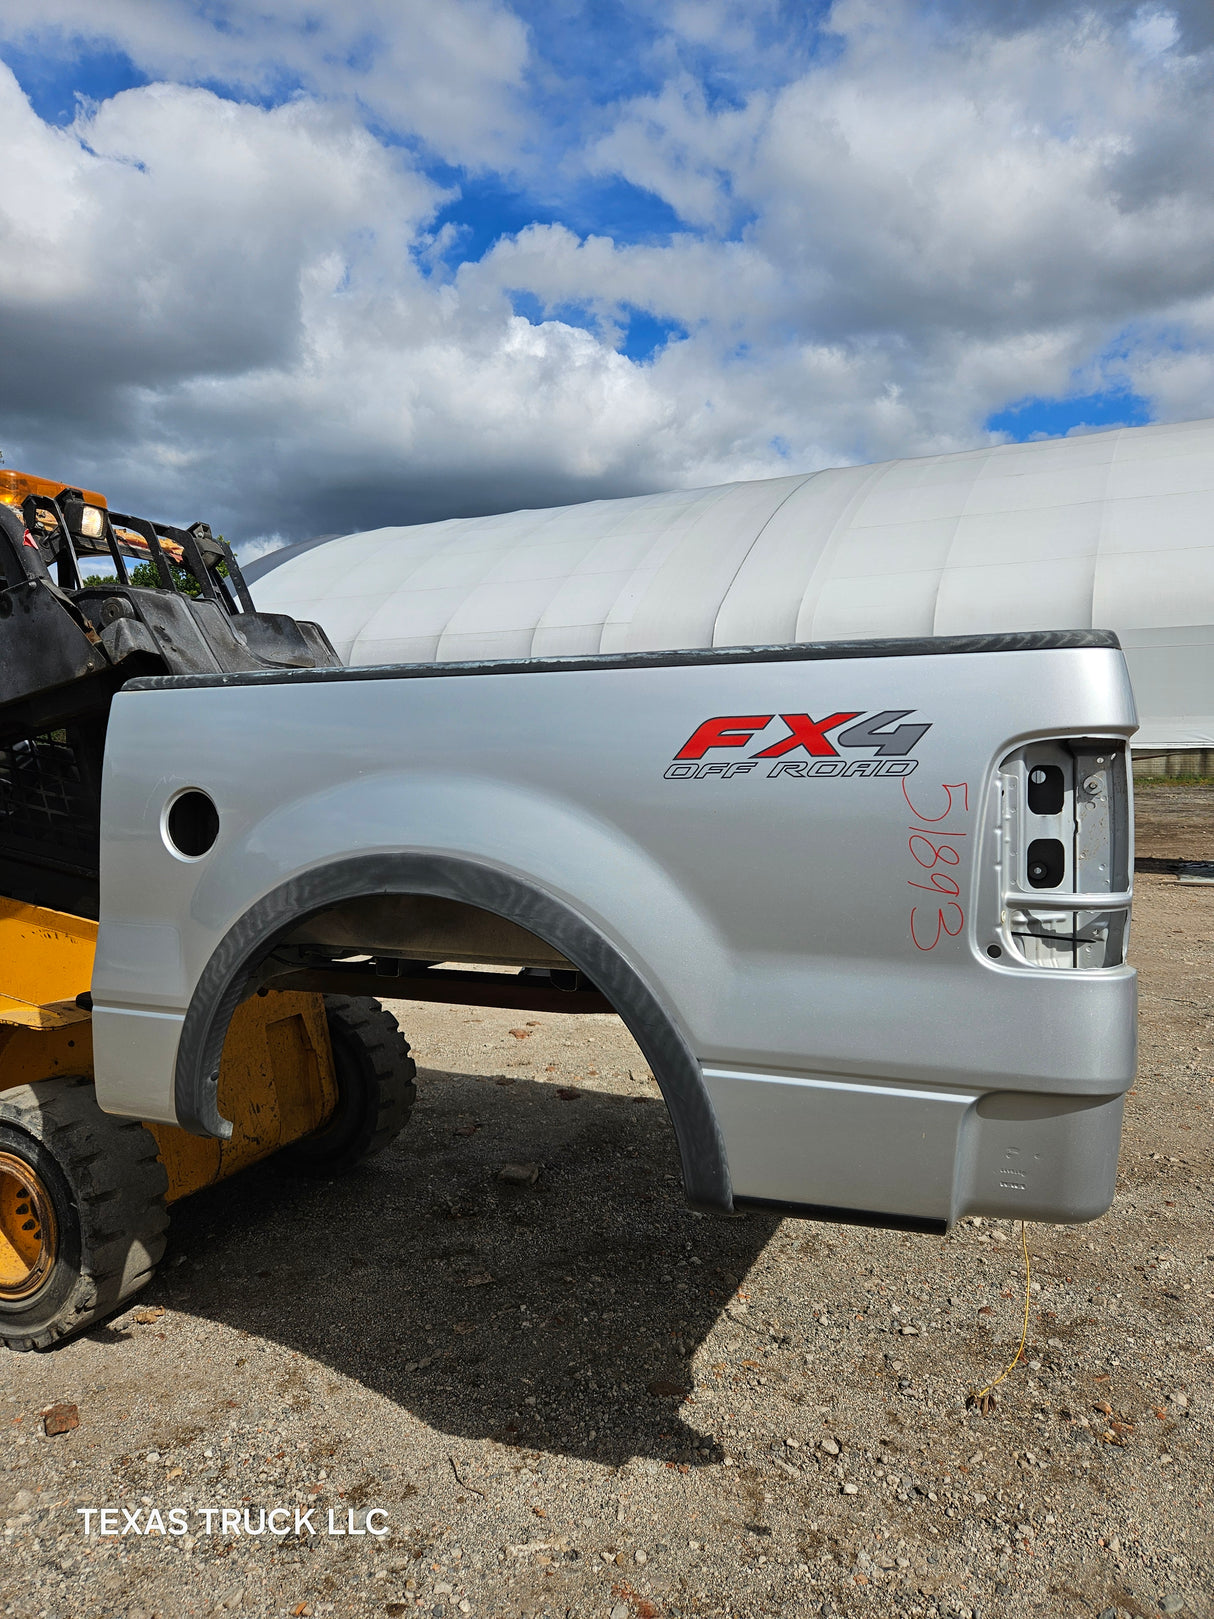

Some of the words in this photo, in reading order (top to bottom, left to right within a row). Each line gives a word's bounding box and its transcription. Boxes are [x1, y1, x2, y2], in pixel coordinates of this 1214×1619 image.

[672, 709, 933, 760] FX4
[663, 762, 758, 780] OFF
[766, 759, 919, 779] ROAD
[902, 776, 968, 951] 51893
